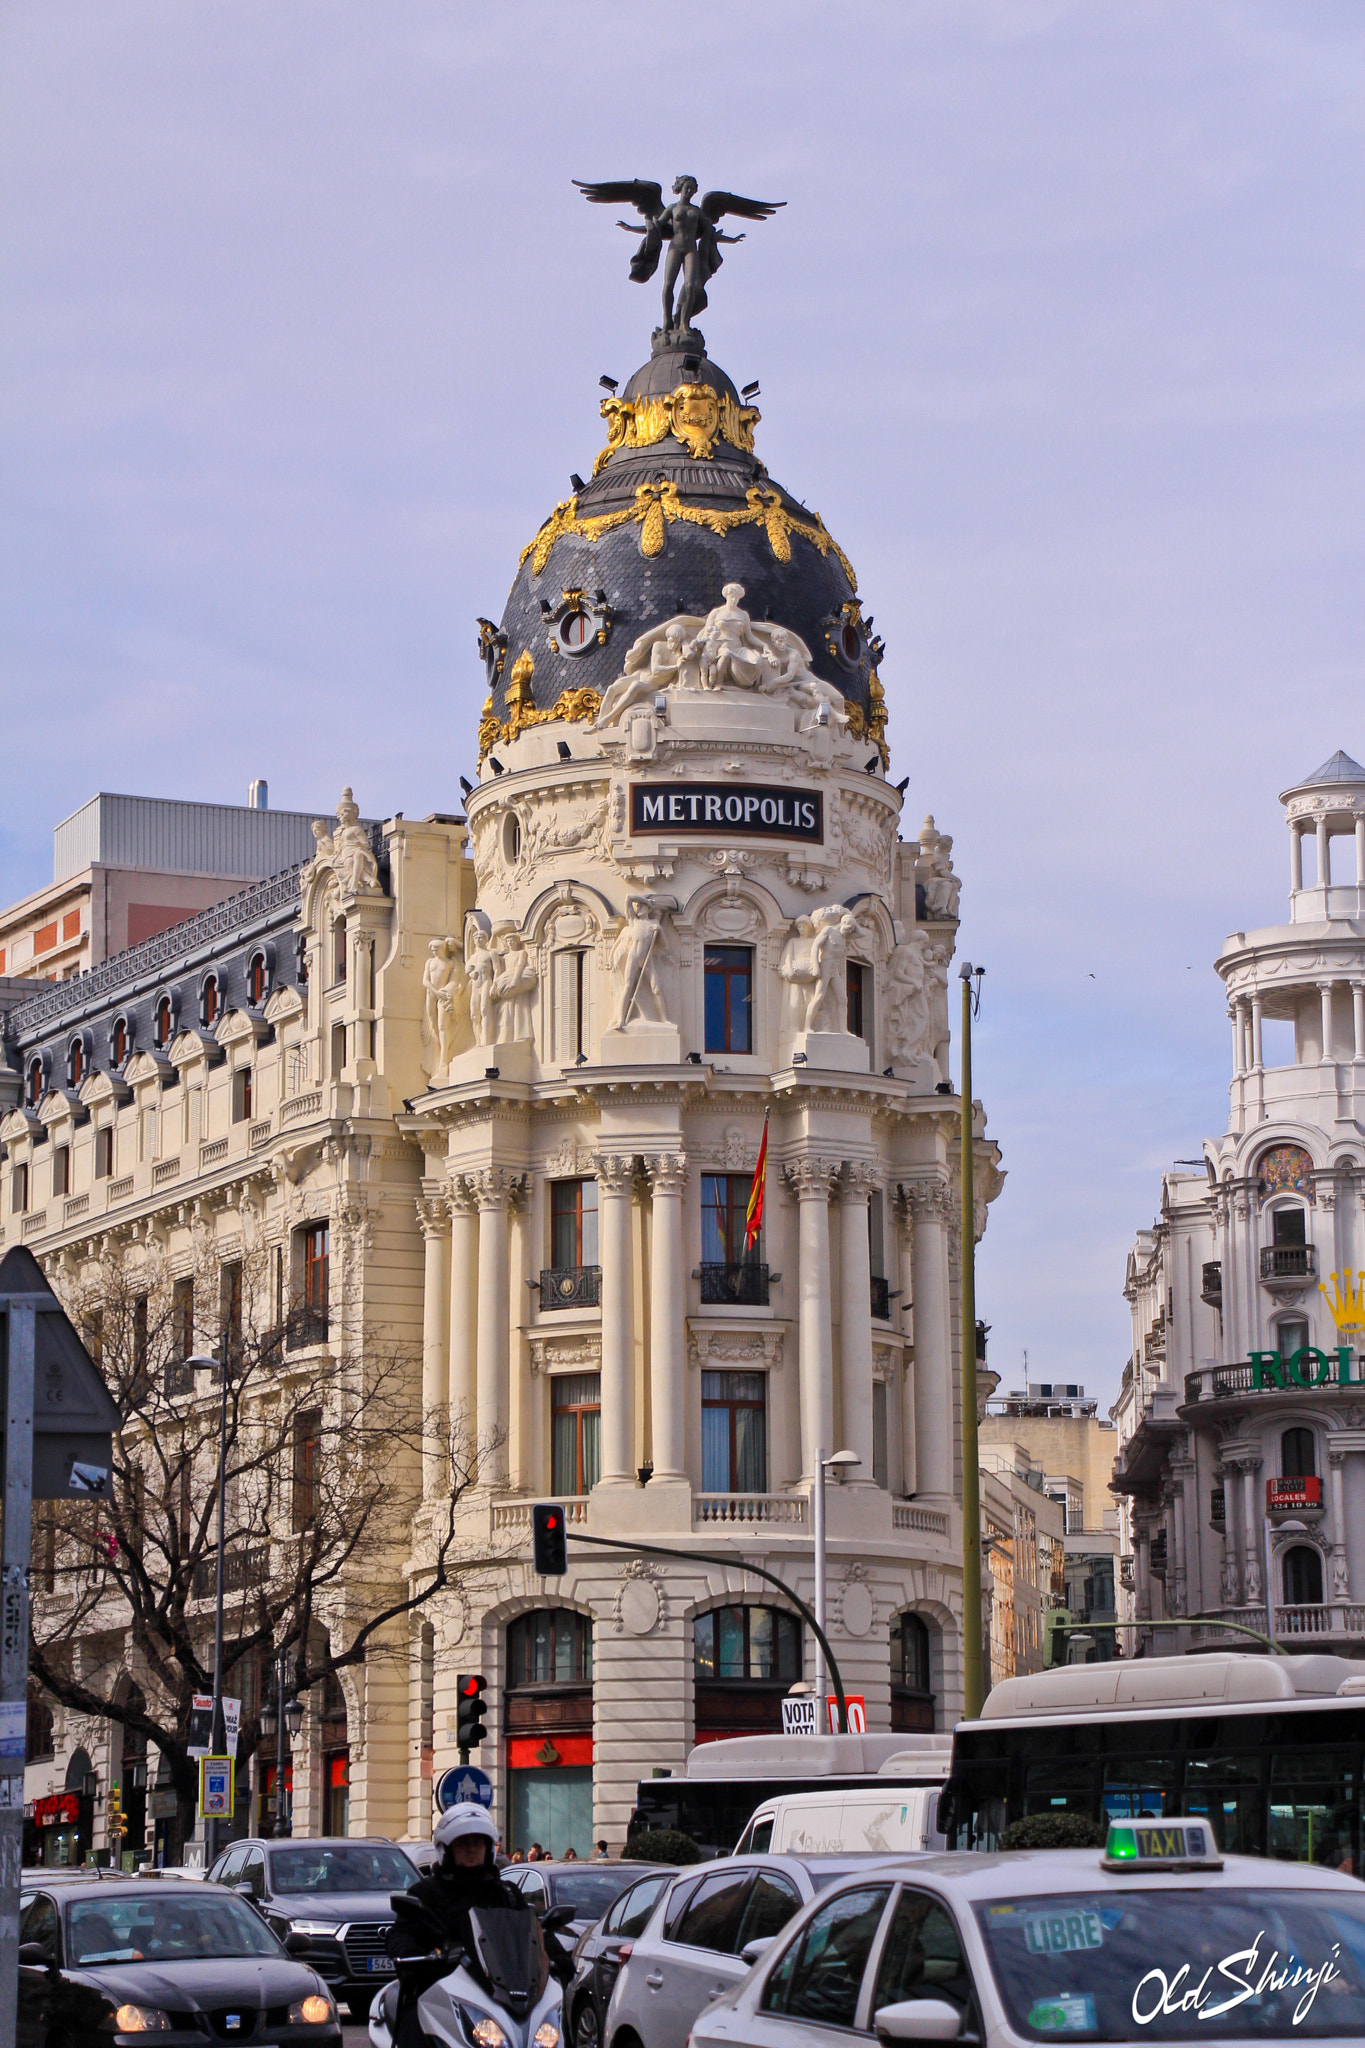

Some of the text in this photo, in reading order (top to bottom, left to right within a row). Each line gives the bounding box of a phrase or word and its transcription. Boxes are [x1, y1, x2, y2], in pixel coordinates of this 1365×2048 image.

[642, 795, 815, 829] METROPOLIS
[1271, 1493, 1306, 1502] LOCALES
[194, 1696, 212, 1708] Fausto
[784, 1702, 815, 1724] VOTA
[1138, 1829, 1184, 1857] TAXI
[1026, 1914, 1100, 1951] LIBRE
